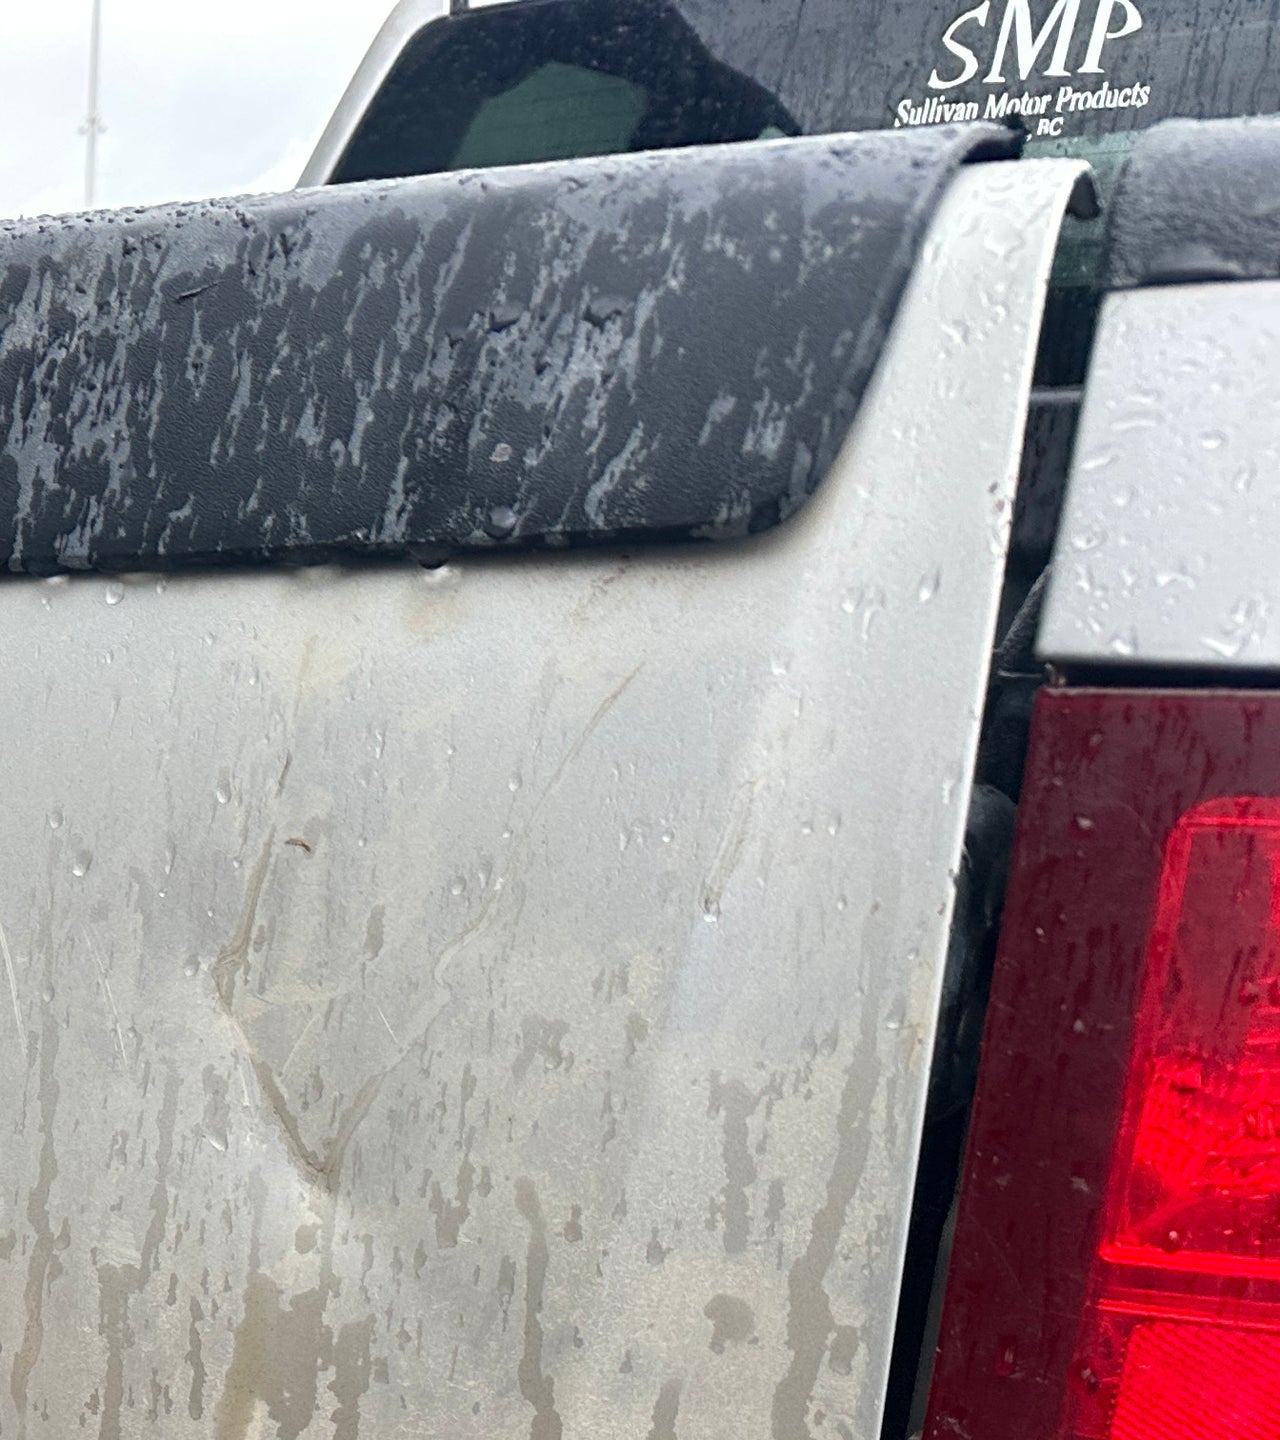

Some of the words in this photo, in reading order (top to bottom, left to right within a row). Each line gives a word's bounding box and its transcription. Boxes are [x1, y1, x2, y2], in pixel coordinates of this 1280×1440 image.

[928, 0, 1142, 89] SMP
[895, 96, 978, 127] Sullivan
[983, 92, 1052, 120] Motor
[1056, 82, 1151, 113] Products
